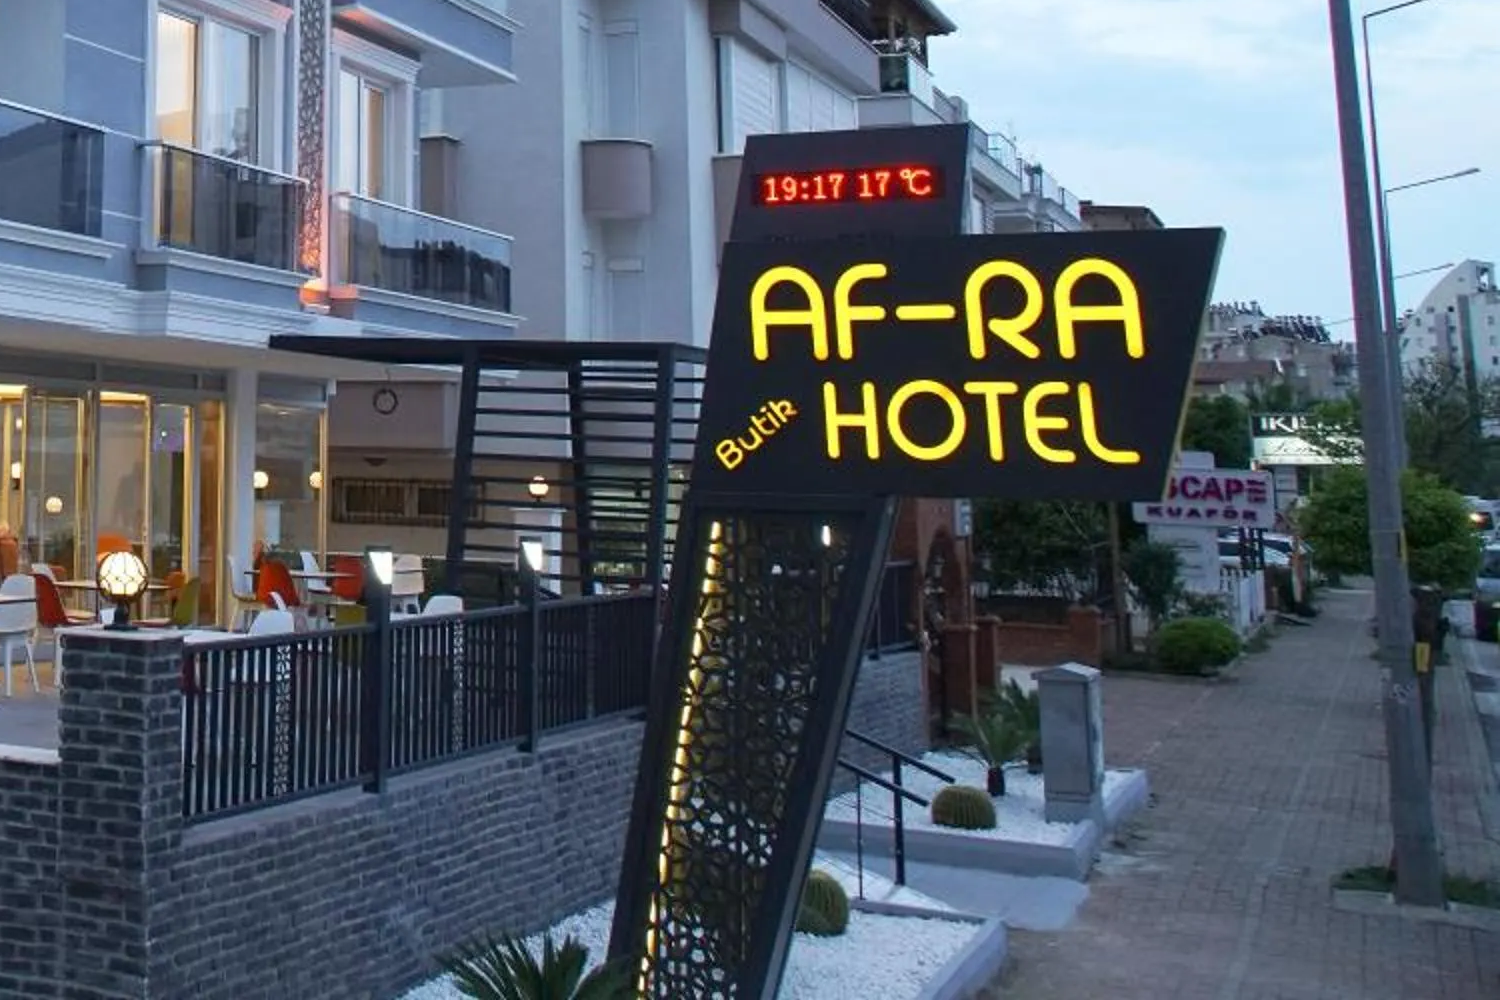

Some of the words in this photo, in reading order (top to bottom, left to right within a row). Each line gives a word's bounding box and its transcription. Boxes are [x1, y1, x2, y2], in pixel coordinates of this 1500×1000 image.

[765, 173, 845, 201] 19:17
[750, 258, 1144, 361] AF-RA
[823, 379, 1141, 464] HOTEL
[1145, 504, 1257, 520] KUAFÖR
